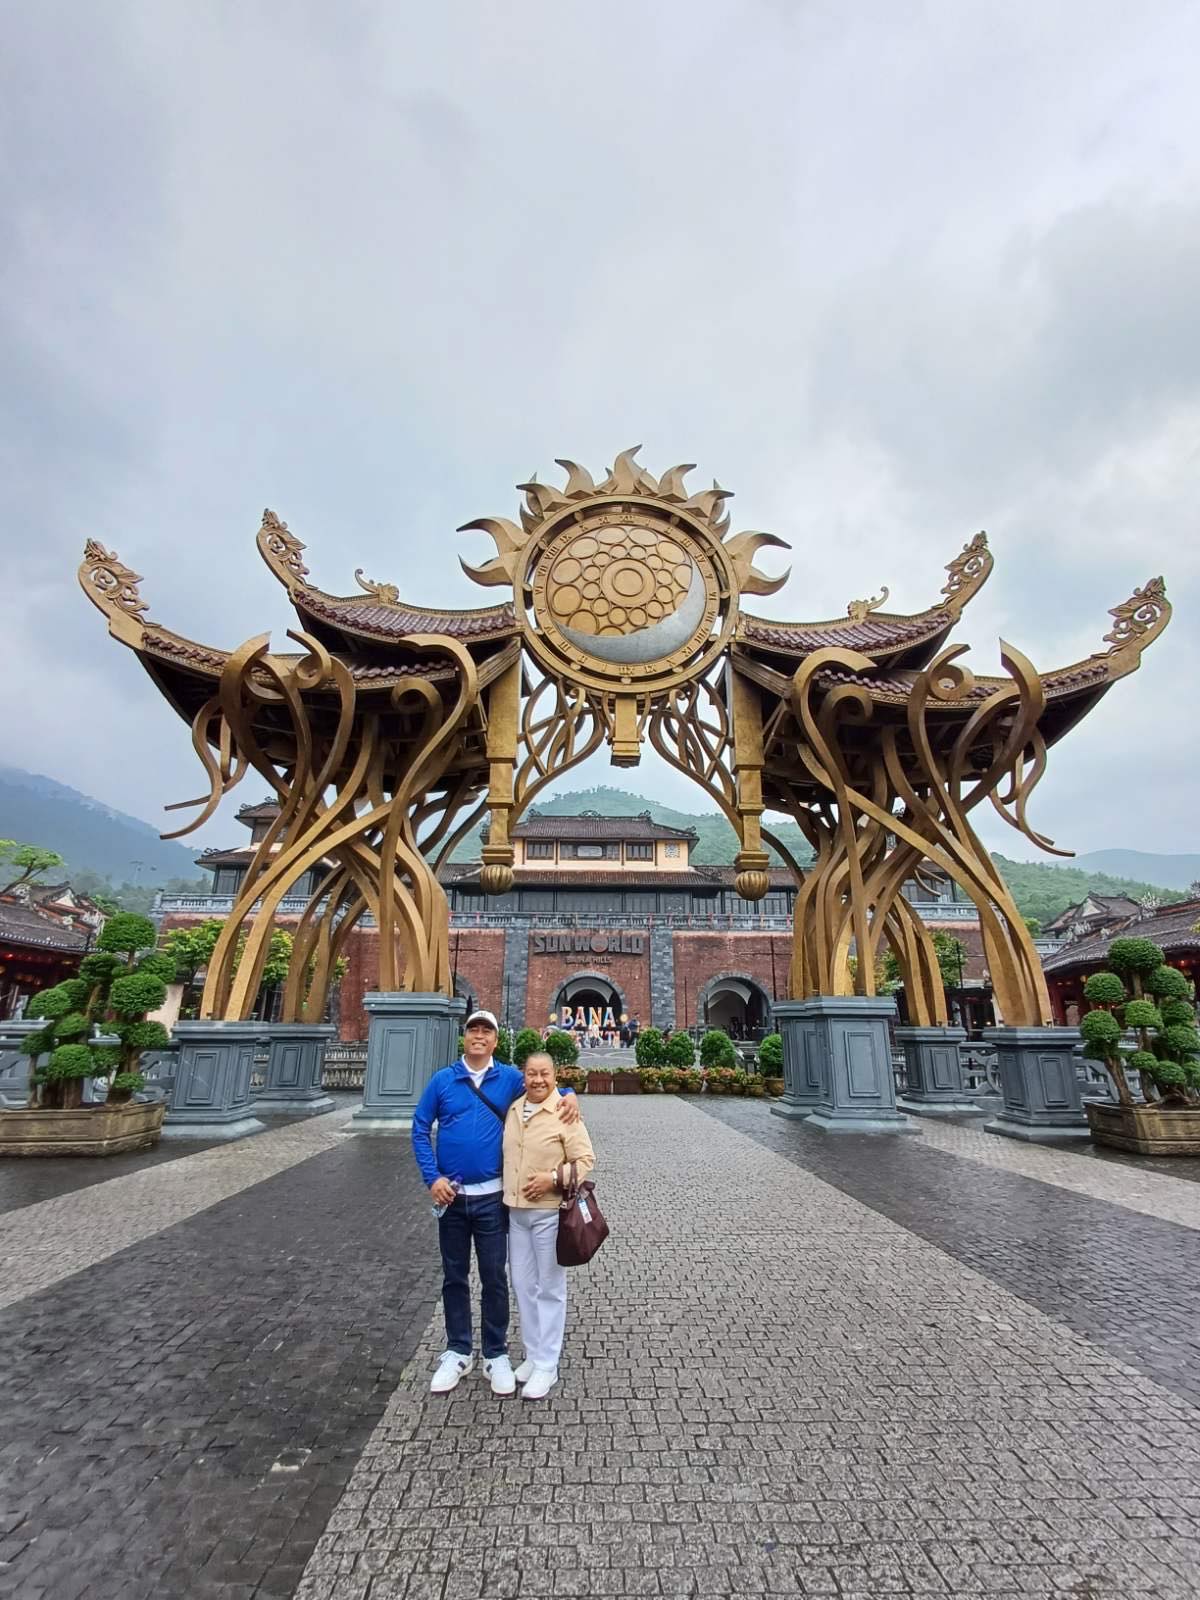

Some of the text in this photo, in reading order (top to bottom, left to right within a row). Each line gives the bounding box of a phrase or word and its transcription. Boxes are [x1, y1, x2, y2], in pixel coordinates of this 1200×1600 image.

[533, 934, 643, 955] SUN WORLD
[561, 1006, 617, 1028] BANA
